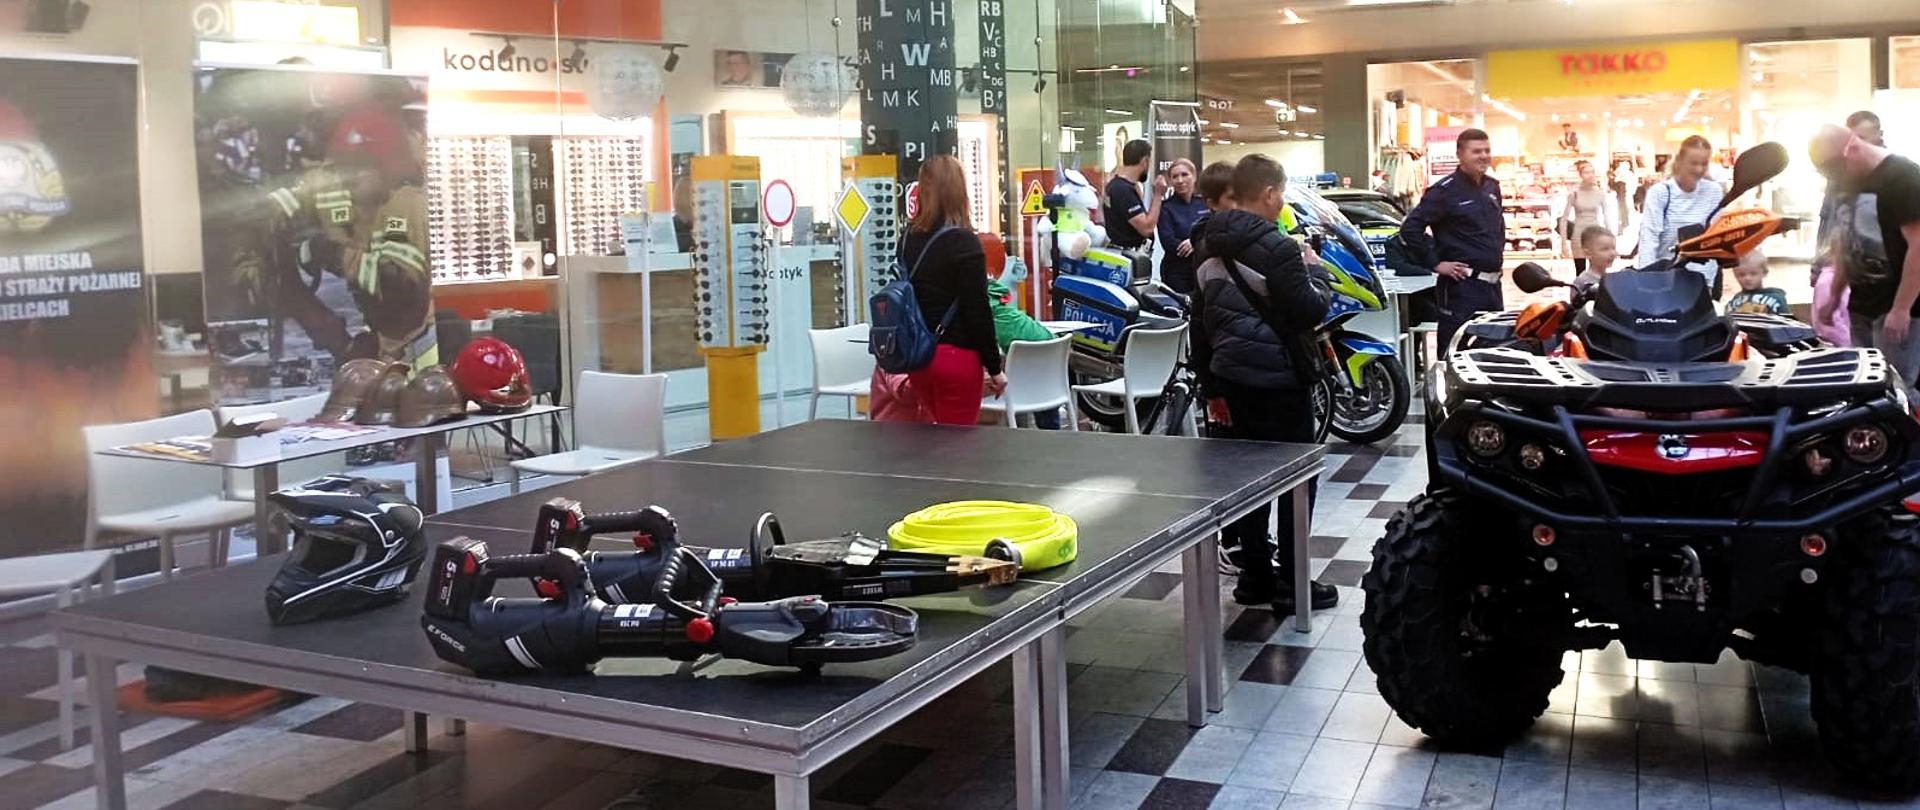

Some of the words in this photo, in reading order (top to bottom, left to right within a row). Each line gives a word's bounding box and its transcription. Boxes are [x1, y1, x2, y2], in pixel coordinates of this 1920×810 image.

[906, 8, 920, 23] M
[930, 1, 945, 26] H
[983, 22, 995, 41] V
[444, 48, 548, 73] kodano
[901, 43, 931, 66] W
[881, 61, 895, 80] H
[883, 90, 899, 108] M
[907, 89, 920, 107] K
[867, 124, 876, 145] S
[24, 252, 92, 271] MIEJSKA
[5, 275, 65, 297] STRAŻY
[69, 270, 141, 292] POŻARNEJ
